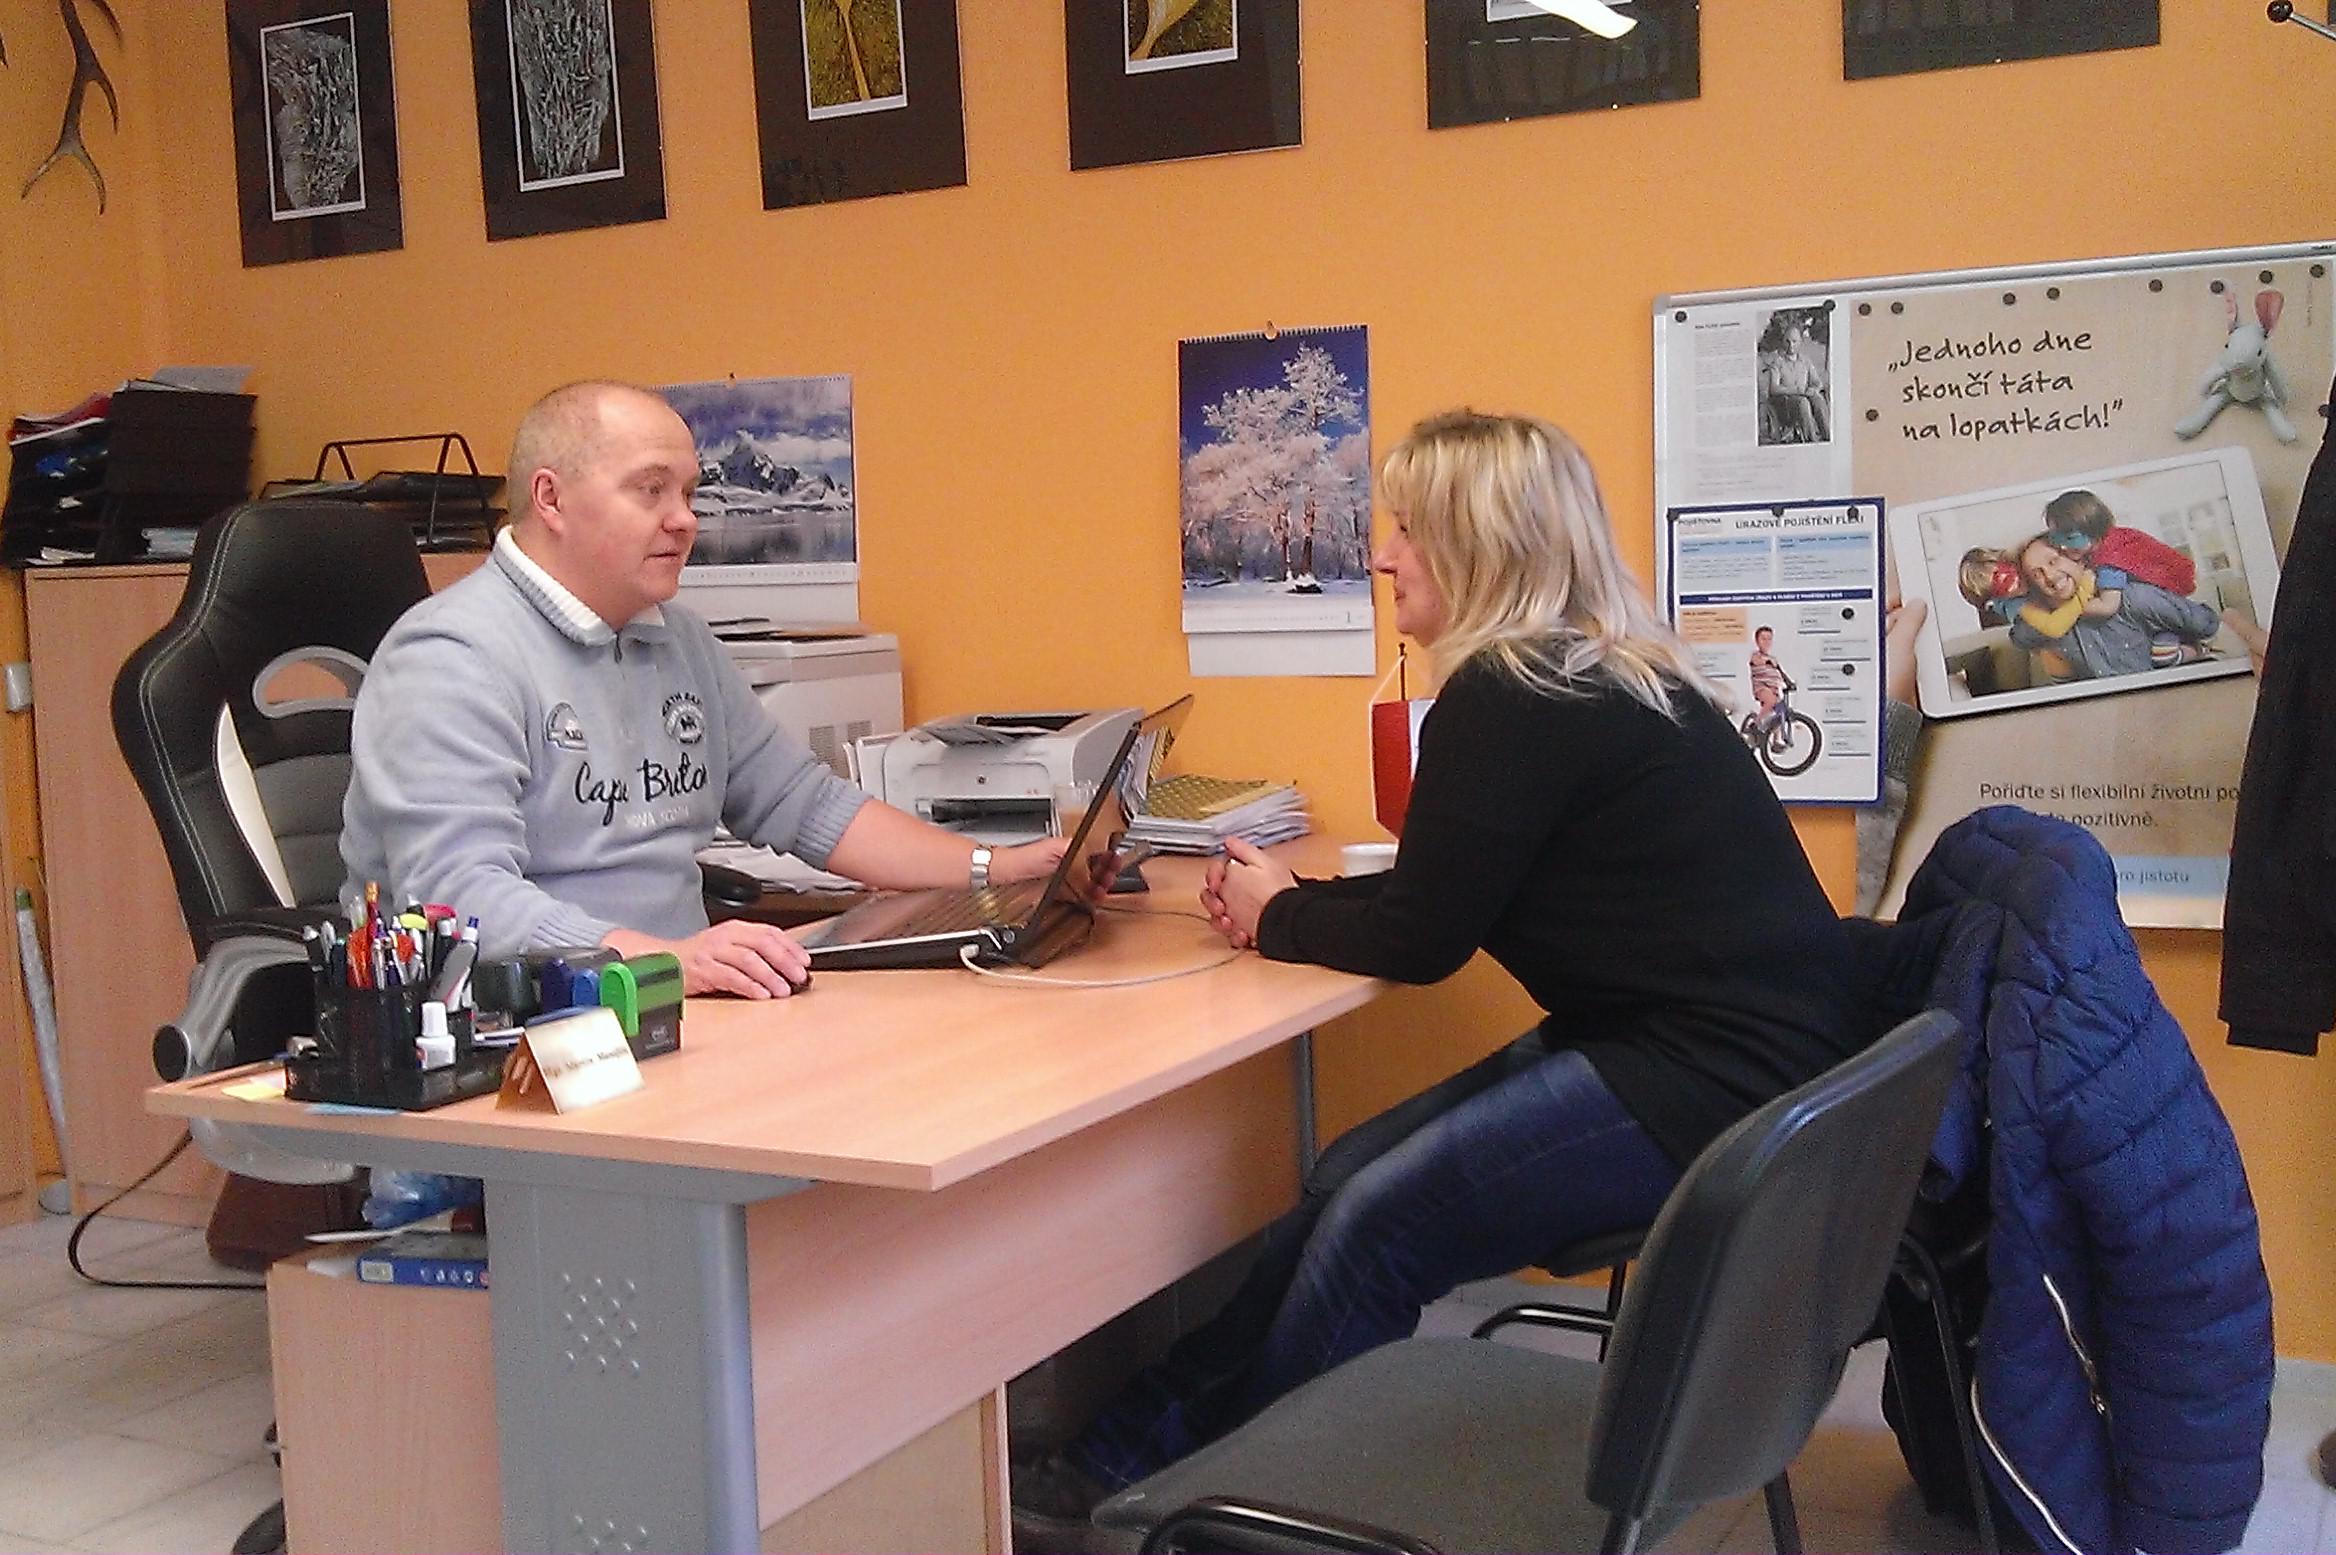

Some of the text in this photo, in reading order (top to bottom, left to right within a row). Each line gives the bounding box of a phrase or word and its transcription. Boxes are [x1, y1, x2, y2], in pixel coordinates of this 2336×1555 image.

[2033, 329, 2092, 353] dne
[1902, 369, 2074, 403] skončí táta
[1902, 421, 1942, 441] na
[2050, 783, 2065, 801] si
